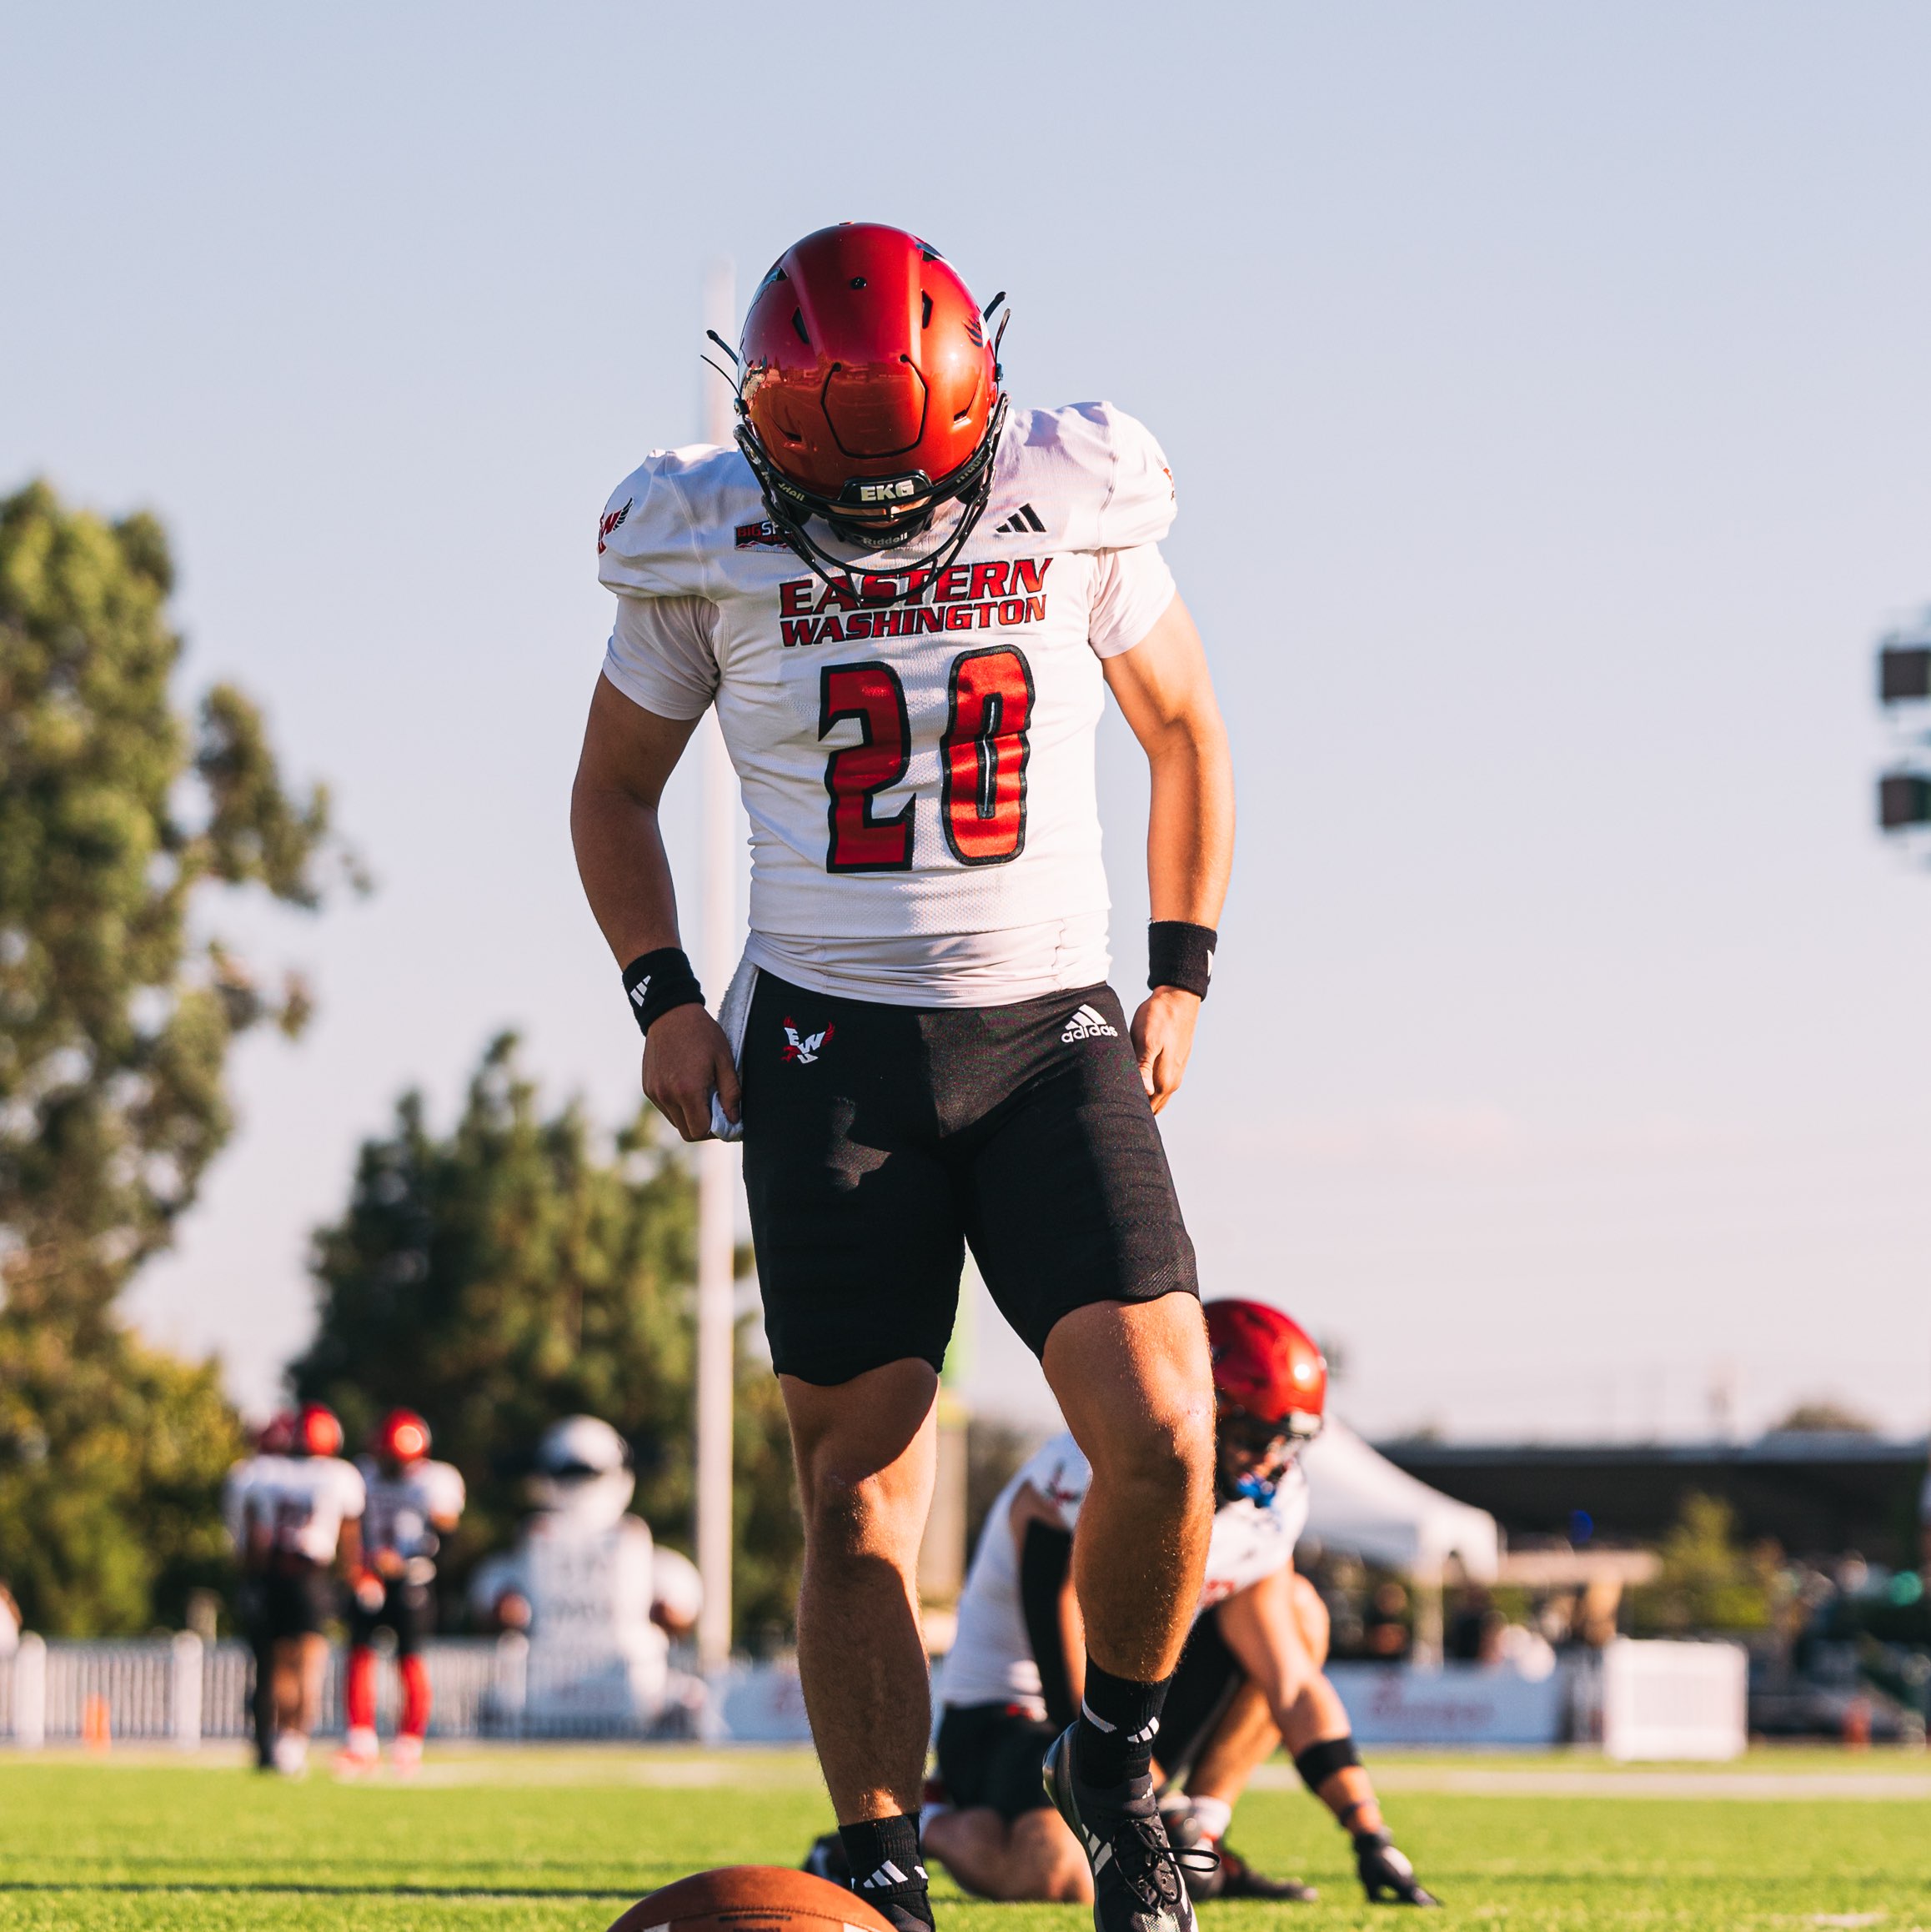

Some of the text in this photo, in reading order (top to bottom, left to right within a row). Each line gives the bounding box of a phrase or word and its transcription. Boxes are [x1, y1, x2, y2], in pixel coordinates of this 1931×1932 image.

[860, 479, 915, 501] EKG
[780, 558, 1053, 618] EASTERN
[780, 595, 1046, 646] WASHINGTON
[819, 645, 1035, 873] 20
[1061, 1024, 1118, 1043] adidas
